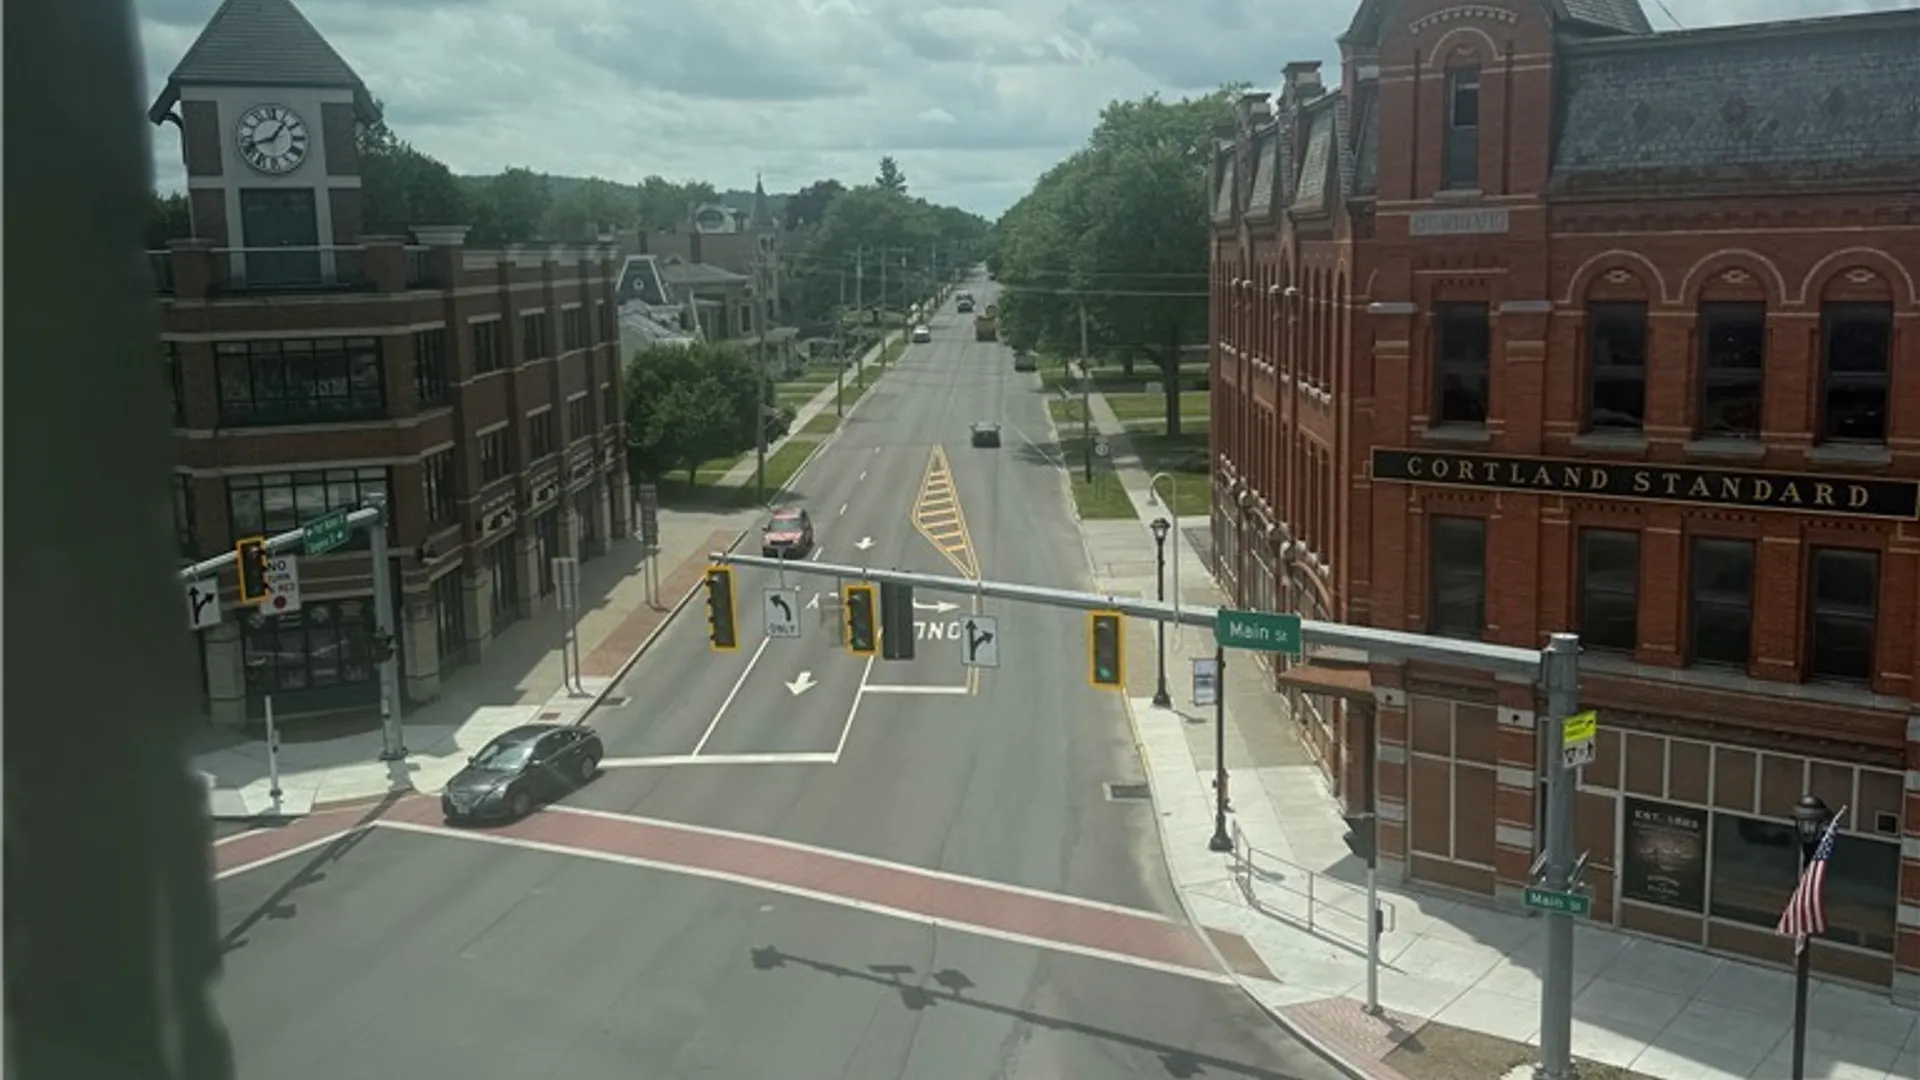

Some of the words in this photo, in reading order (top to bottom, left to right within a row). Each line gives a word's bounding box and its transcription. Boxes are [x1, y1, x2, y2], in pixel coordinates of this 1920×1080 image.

[1407, 457, 1608, 489] CORTLAND
[1633, 471, 1869, 507] STANDARD
[769, 622, 796, 635] ONLY
[1229, 621, 1269, 640] Main
[1531, 892, 1564, 909] Main
